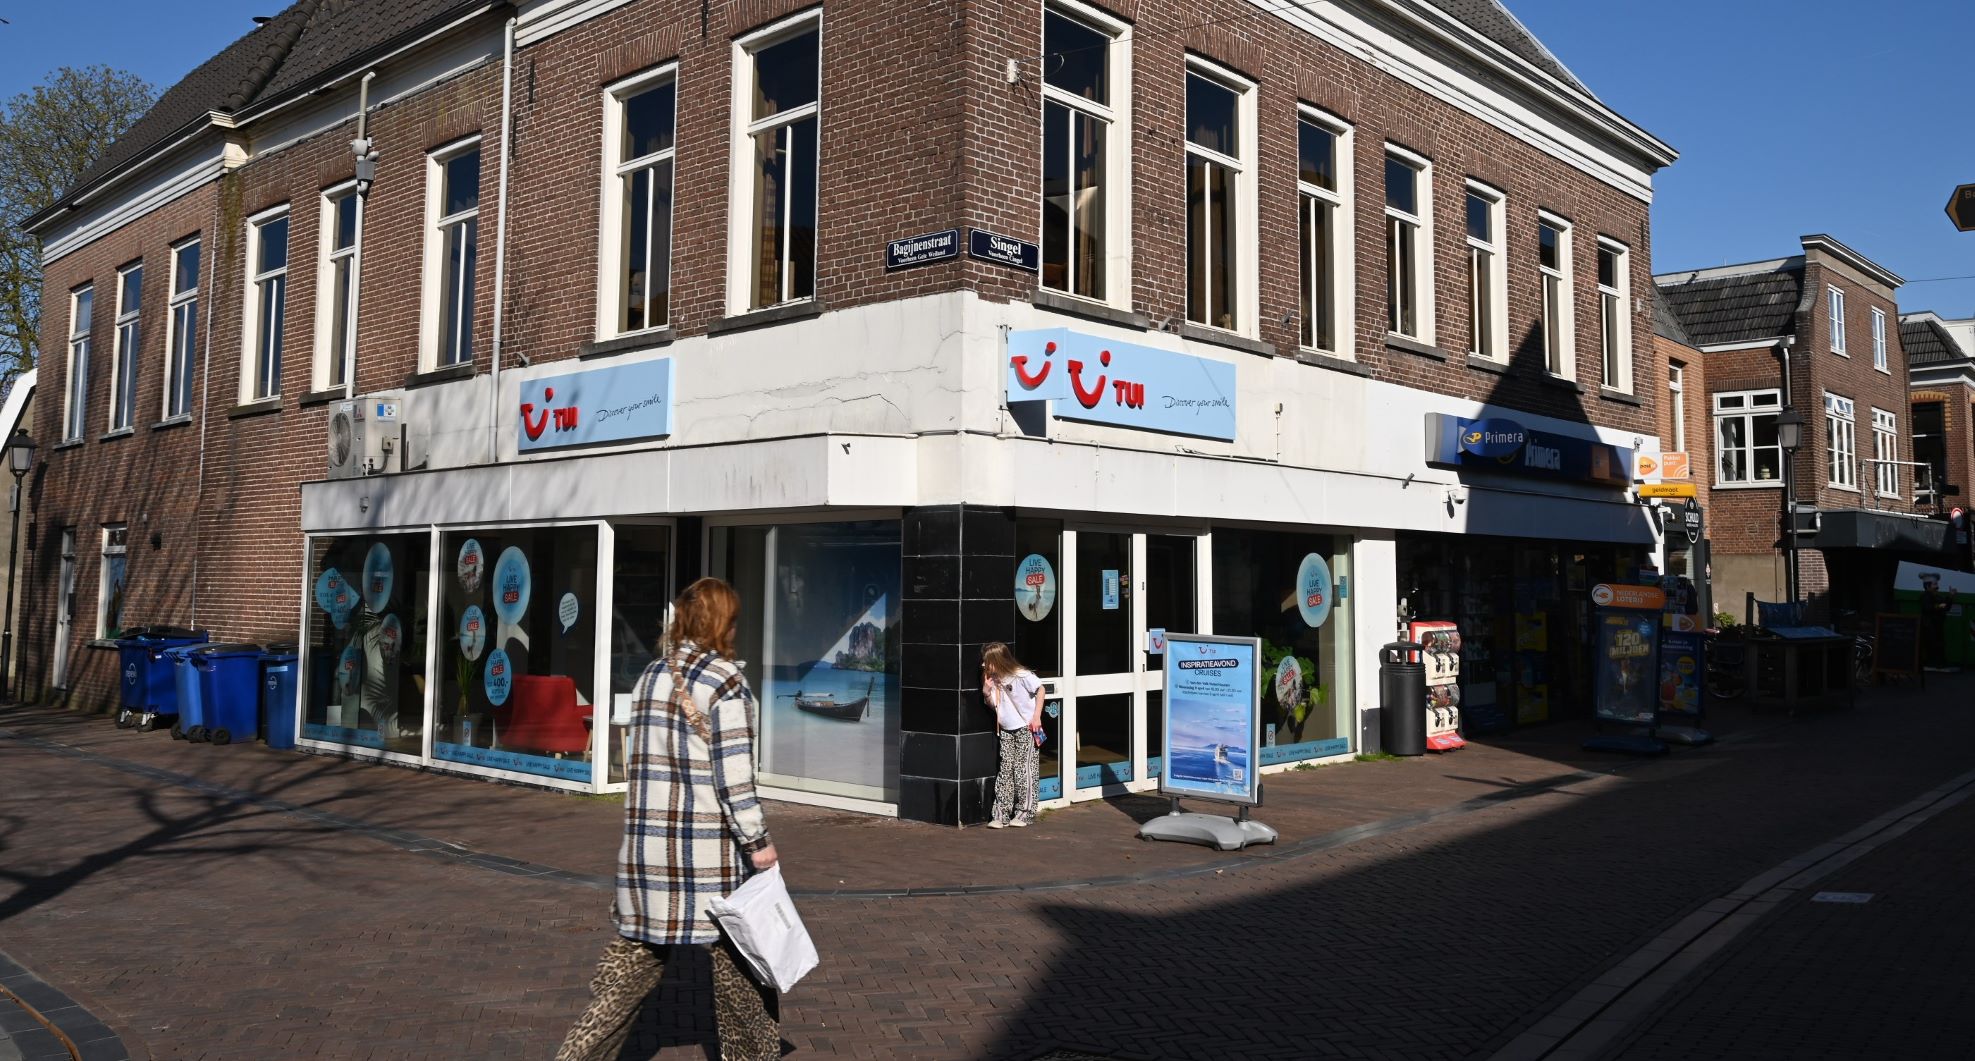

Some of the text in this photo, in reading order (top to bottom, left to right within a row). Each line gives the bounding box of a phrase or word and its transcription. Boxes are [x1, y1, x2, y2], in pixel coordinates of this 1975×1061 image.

[893, 234, 952, 257] Bagijnenstraat
[990, 236, 1021, 256] Singel
[1112, 379, 1144, 410] TUI
[596, 393, 662, 422] Discover your smile
[1161, 395, 1231, 415] Discover your smile
[553, 406, 580, 432] TUI
[1485, 431, 1524, 444] Primera
[1025, 566, 1046, 574] HAPPY
[506, 575, 518, 583] LIVE
[1027, 576, 1044, 585] SALE
[1309, 580, 1320, 588] LIVE
[503, 583, 520, 592] HAPPY
[1307, 587, 1322, 596] HAPPY
[504, 593, 518, 602] SALE
[1308, 595, 1321, 606] SALE
[1615, 632, 1641, 647] 120
[1180, 660, 1236, 669] INSPIRATIEAVOND
[1194, 669, 1222, 677] CRUISES
